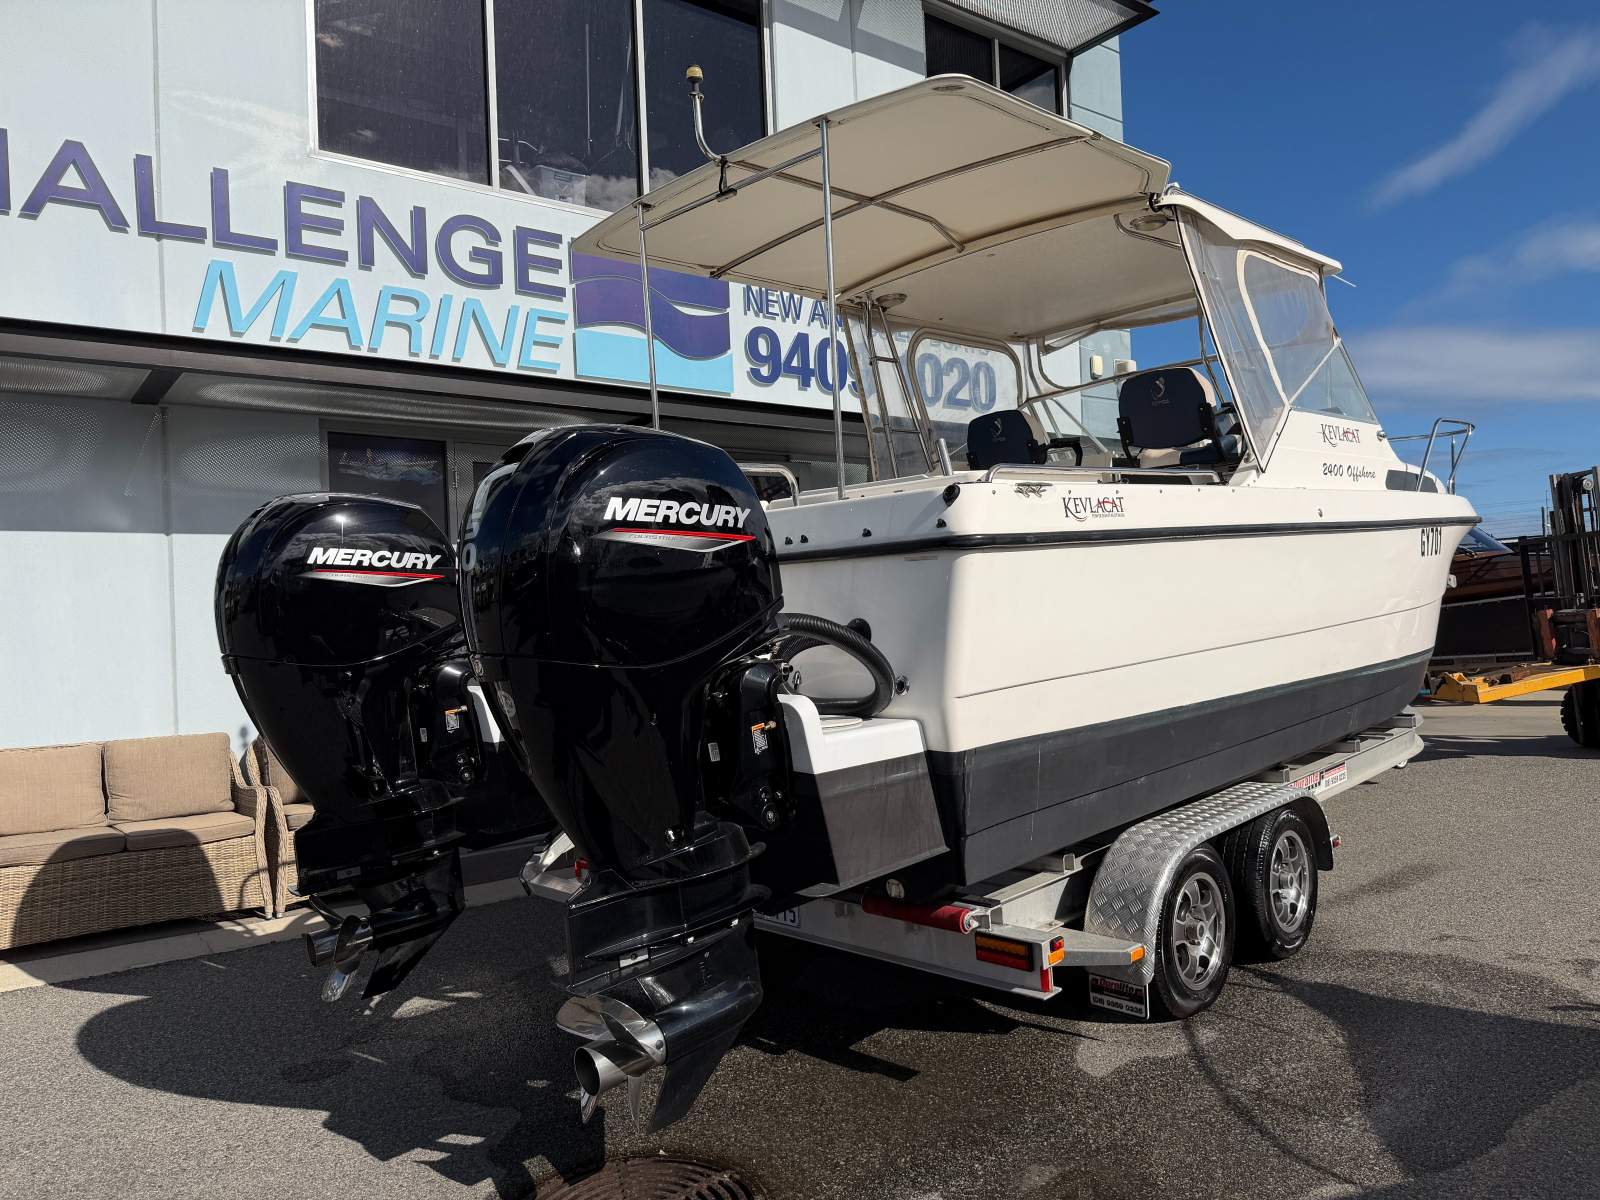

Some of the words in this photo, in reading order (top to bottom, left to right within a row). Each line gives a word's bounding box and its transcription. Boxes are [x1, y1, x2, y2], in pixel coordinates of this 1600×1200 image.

[192, 259, 569, 375] MARINE
[743, 284, 803, 325] NEW
[1320, 423, 1361, 447] KEVLACAT
[1322, 462, 1344, 477] 2400
[1346, 464, 1377, 482] Offshore
[603, 496, 751, 528] MERCURY
[1061, 496, 1124, 522] KEVLACAT
[1420, 526, 1442, 558] GY701
[306, 547, 442, 570] MERCURY
